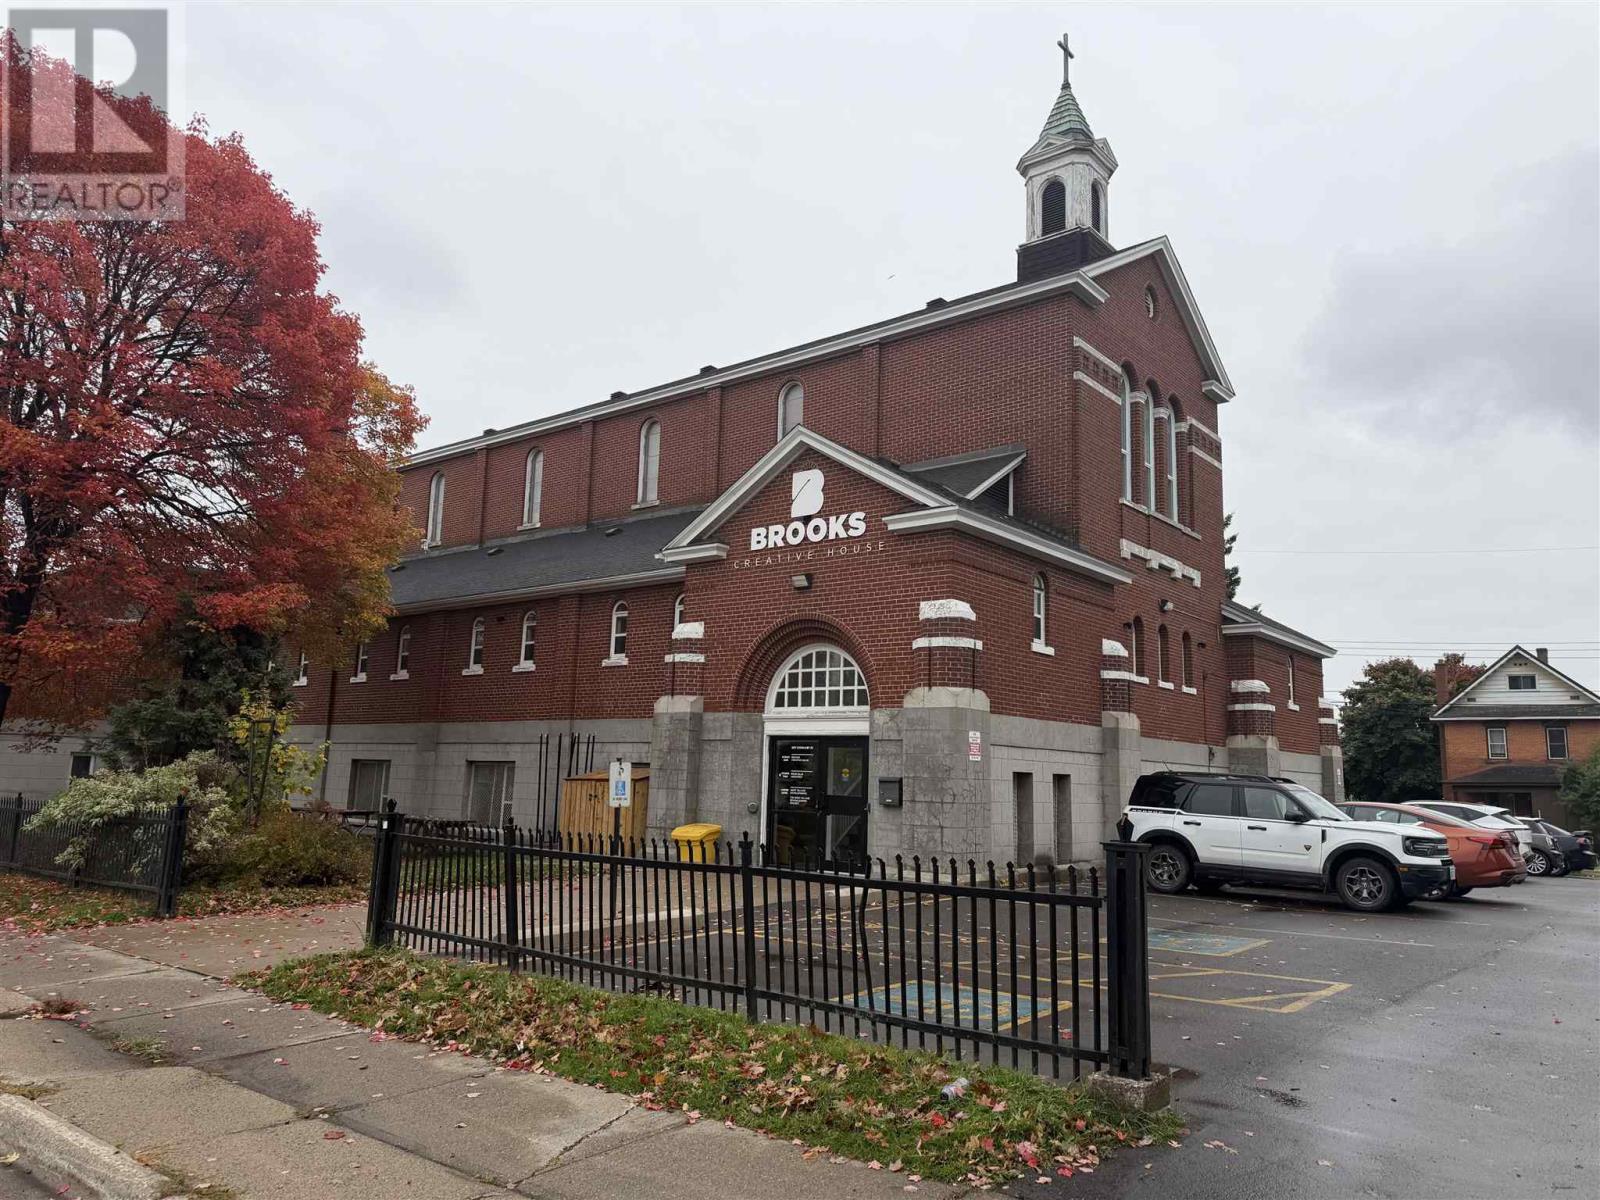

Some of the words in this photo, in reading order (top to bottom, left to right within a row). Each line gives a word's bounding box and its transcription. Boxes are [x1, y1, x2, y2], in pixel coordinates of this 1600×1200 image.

[751, 512, 867, 551] BROOKS
[733, 552, 813, 569] CREATIVE
[827, 541, 886, 557] HOUSE
